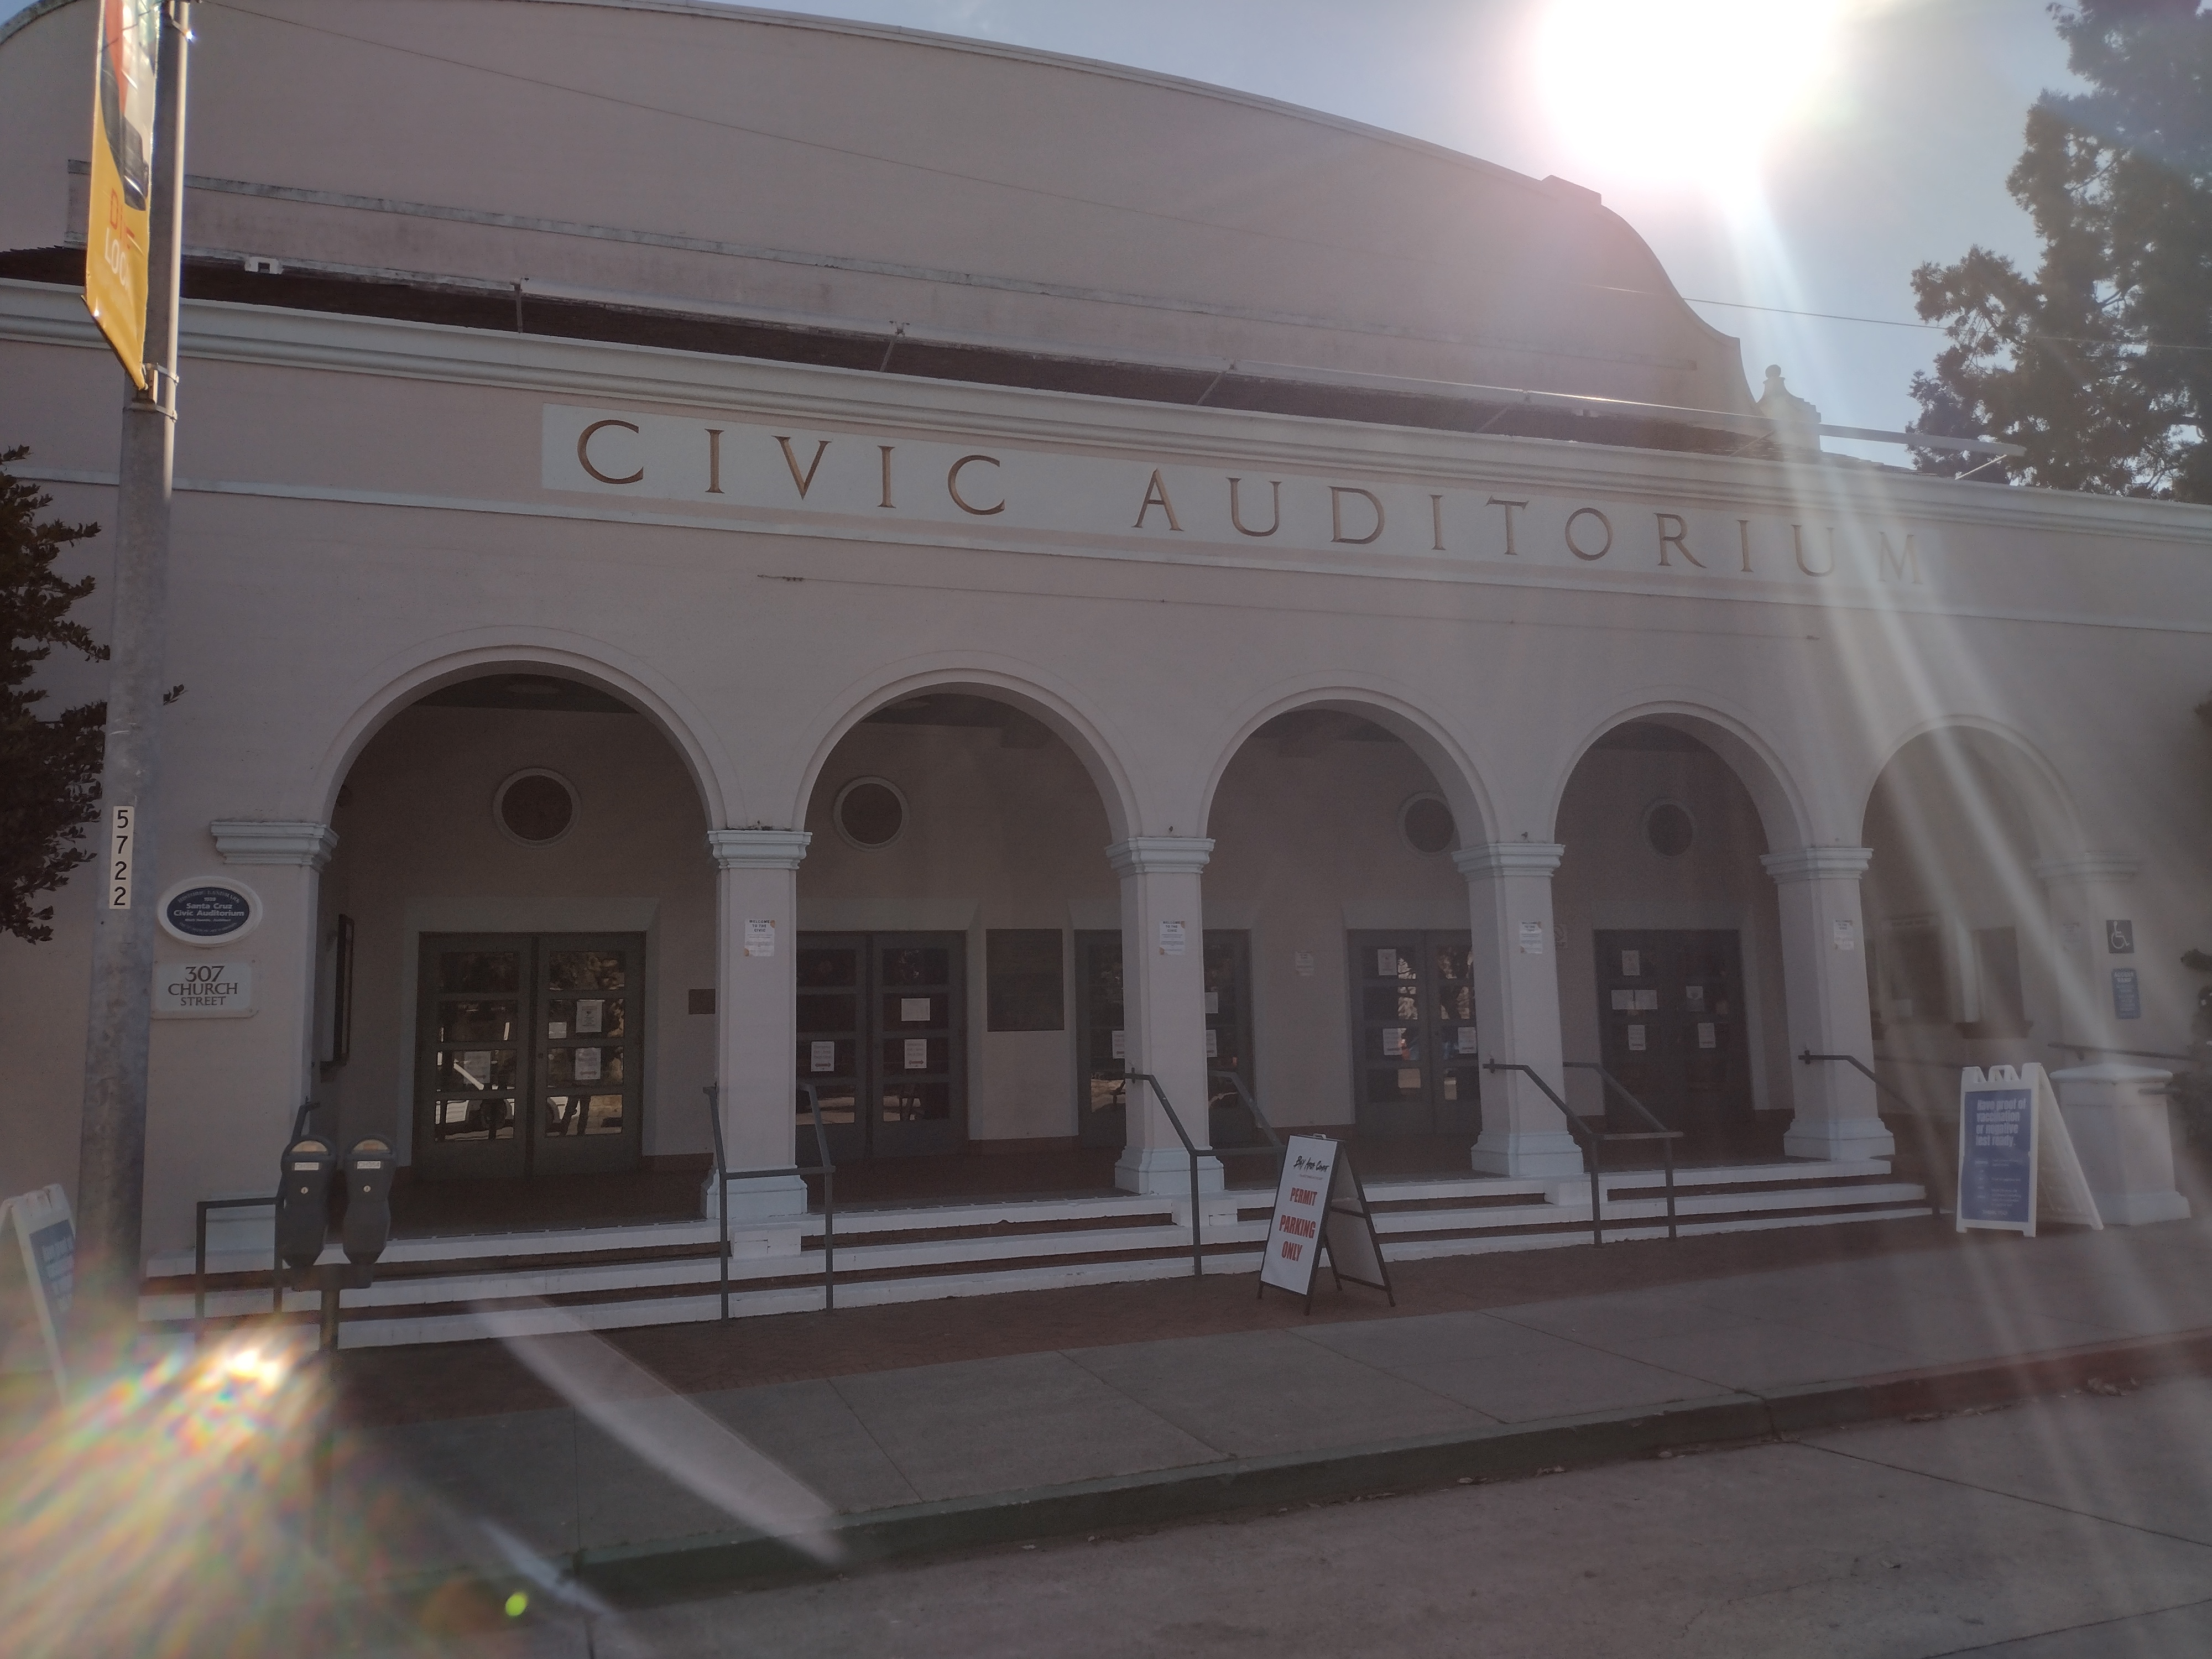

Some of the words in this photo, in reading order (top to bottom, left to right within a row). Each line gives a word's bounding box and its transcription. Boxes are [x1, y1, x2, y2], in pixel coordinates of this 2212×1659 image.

[577, 419, 1005, 515] CIVIC
[1131, 468, 1923, 585] AUDITORIUM
[113, 810, 128, 905] 5722
[185, 965, 225, 982] 307
[168, 982, 238, 995] CHURCH
[180, 996, 226, 1006] STREET
[1289, 1187, 1318, 1207] PERMIT
[1279, 1214, 1316, 1239] PARKING
[1281, 1240, 1303, 1262] ONLY
